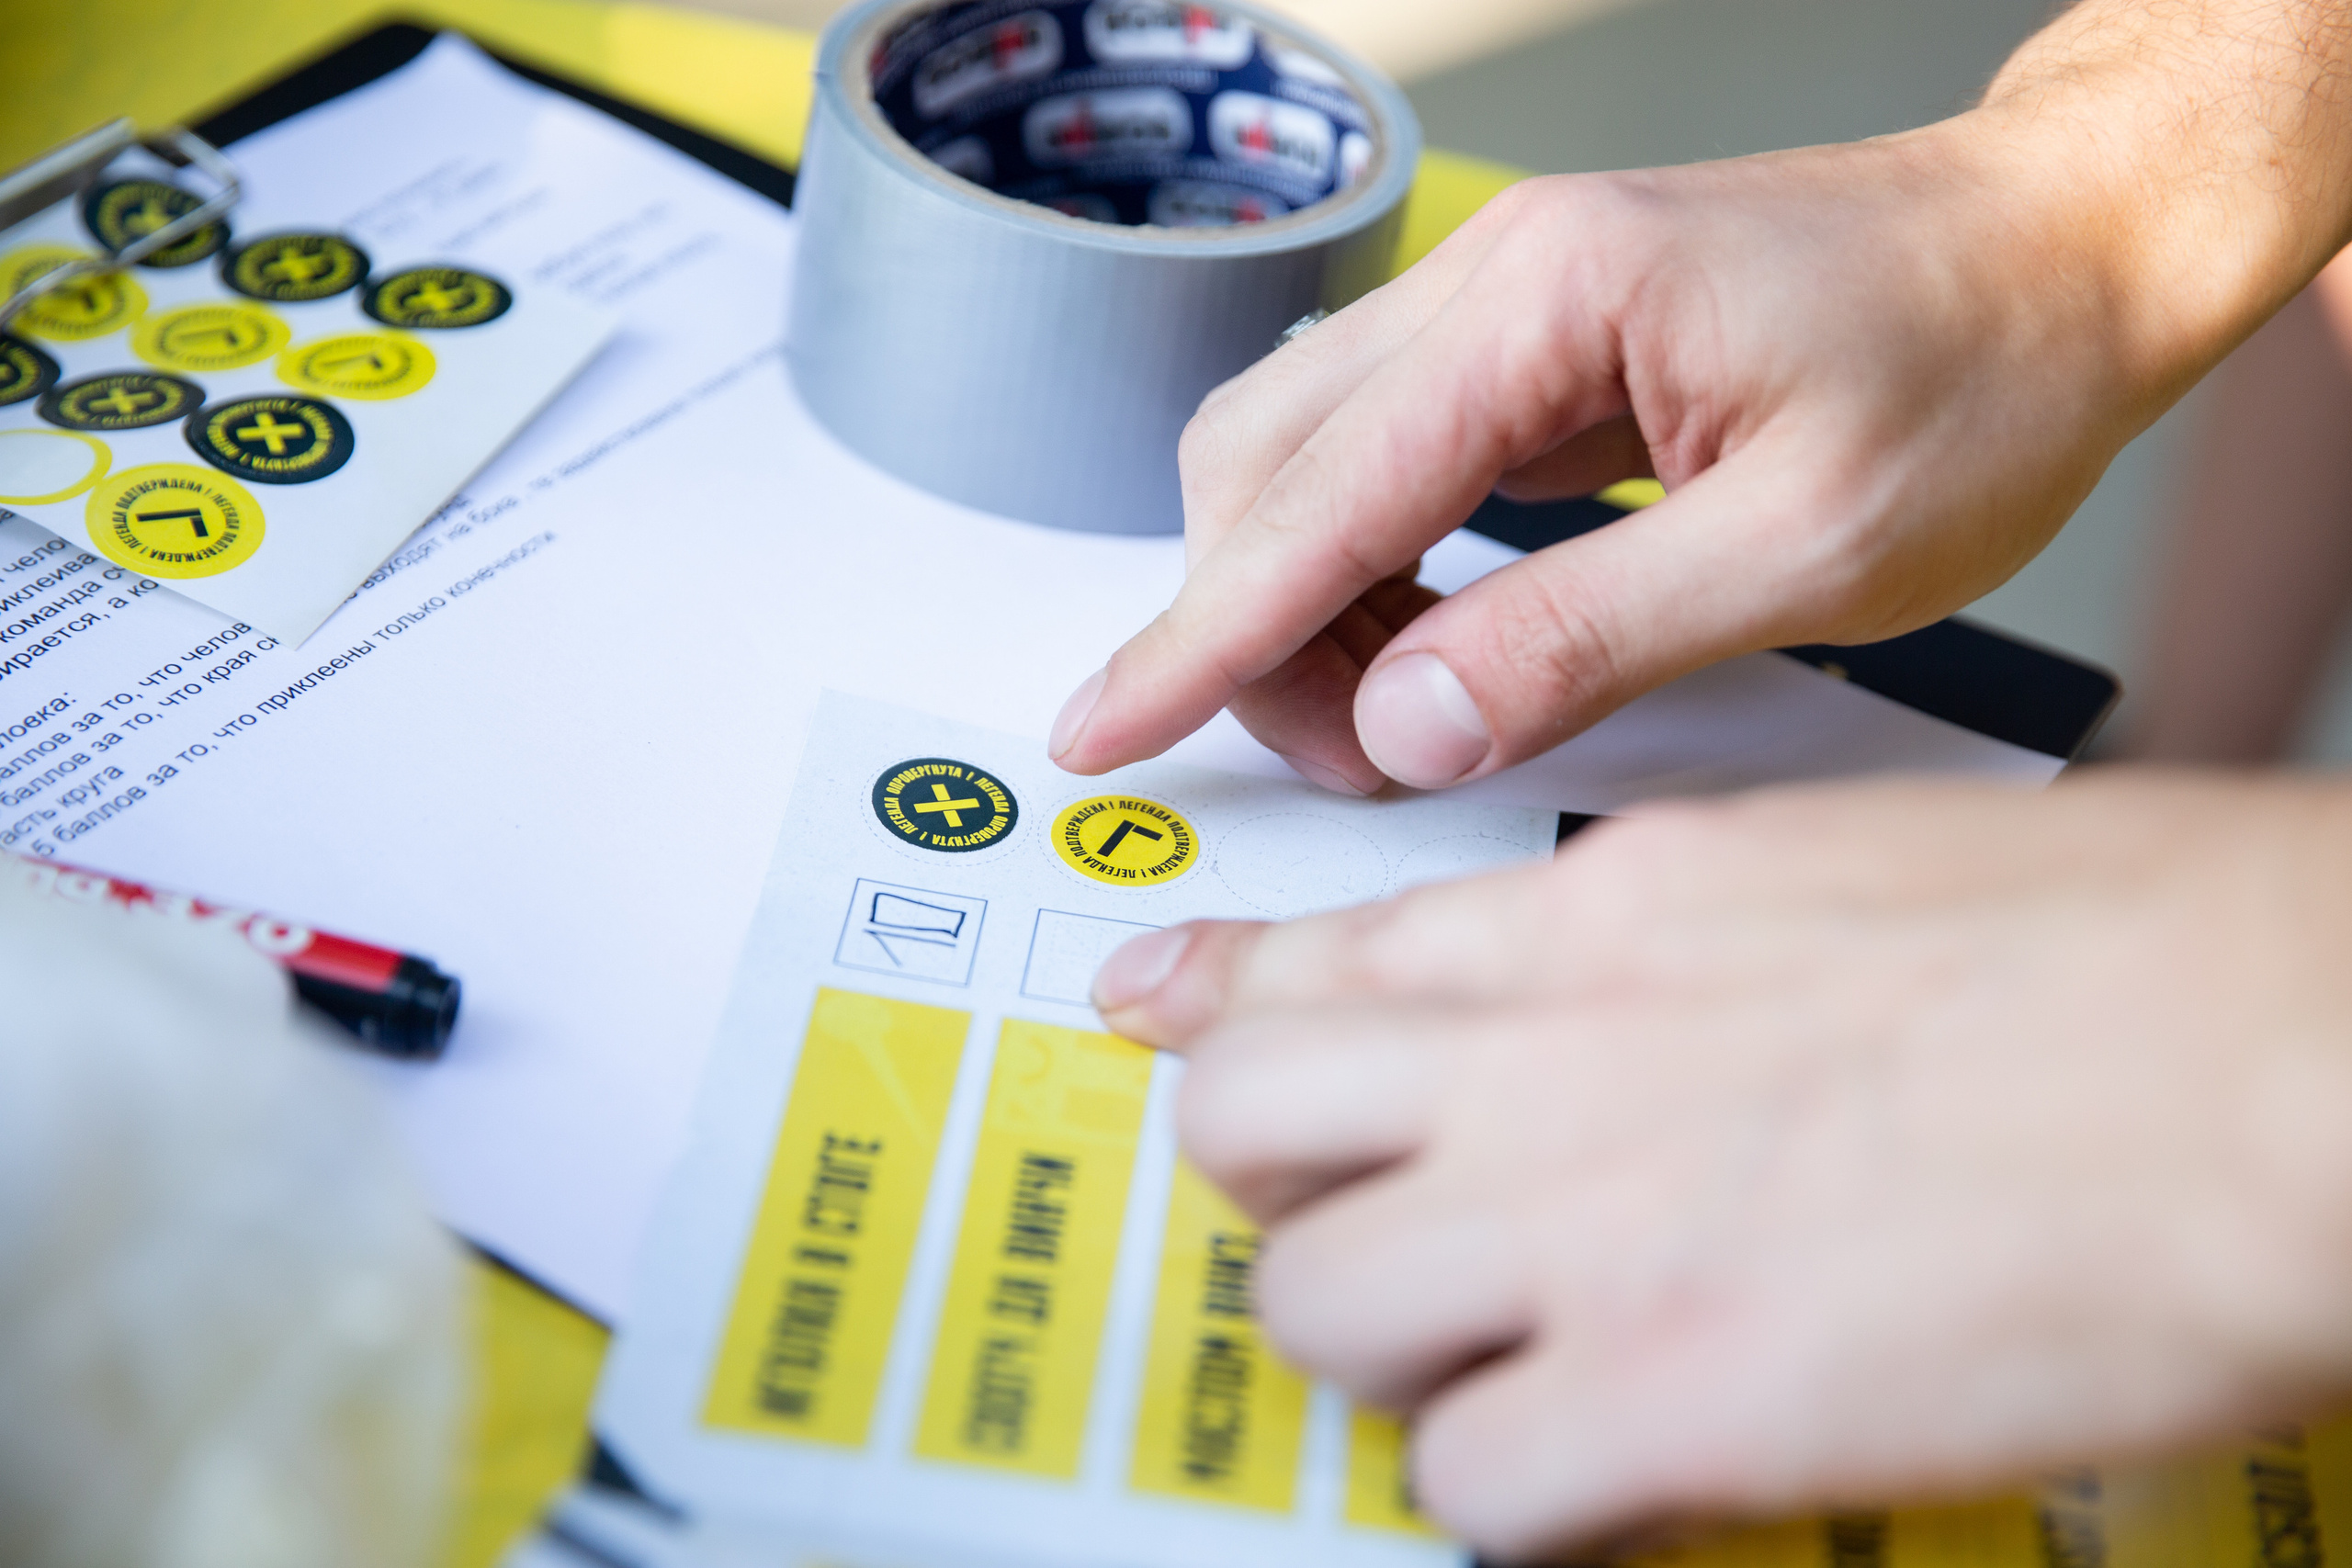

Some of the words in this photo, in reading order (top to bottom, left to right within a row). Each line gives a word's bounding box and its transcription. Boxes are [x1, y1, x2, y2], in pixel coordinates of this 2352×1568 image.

[3, 536, 72, 572] чело
[107, 596, 130, 609] а
[71, 712, 104, 732] за
[100, 694, 143, 711] то,
[138, 663, 182, 686] что
[180, 622, 252, 661] челов
[0, 752, 91, 807] баллов
[90, 732, 123, 752] за
[119, 713, 164, 730] то,
[158, 683, 202, 706] что
[201, 649, 257, 683] края
[30, 838, 55, 858] 5
[52, 785, 147, 842] баллов
[145, 763, 179, 786] за
[175, 744, 219, 763] то,
[212, 714, 257, 738] что
[255, 640, 377, 715] приклеены
[371, 596, 447, 641] только
[56, 766, 124, 808] круга
[886, 764, 962, 795] ОПРОВЕРГНУТА
[974, 777, 1010, 812] ЛЕГЕНДА
[884, 797, 919, 834] ЛЕГЕНДА
[932, 815, 1009, 846] ОПРОВЕРГНУТА
[1065, 802, 1107, 857] ПОДТВЕРЖДЕНА
[1119, 800, 1171, 822] ЛЕГЕНДА
[1148, 821, 1190, 876] ПОДТВЕРЖДЕНА
[1082, 855, 1136, 878] ЛЕГЕНДА
